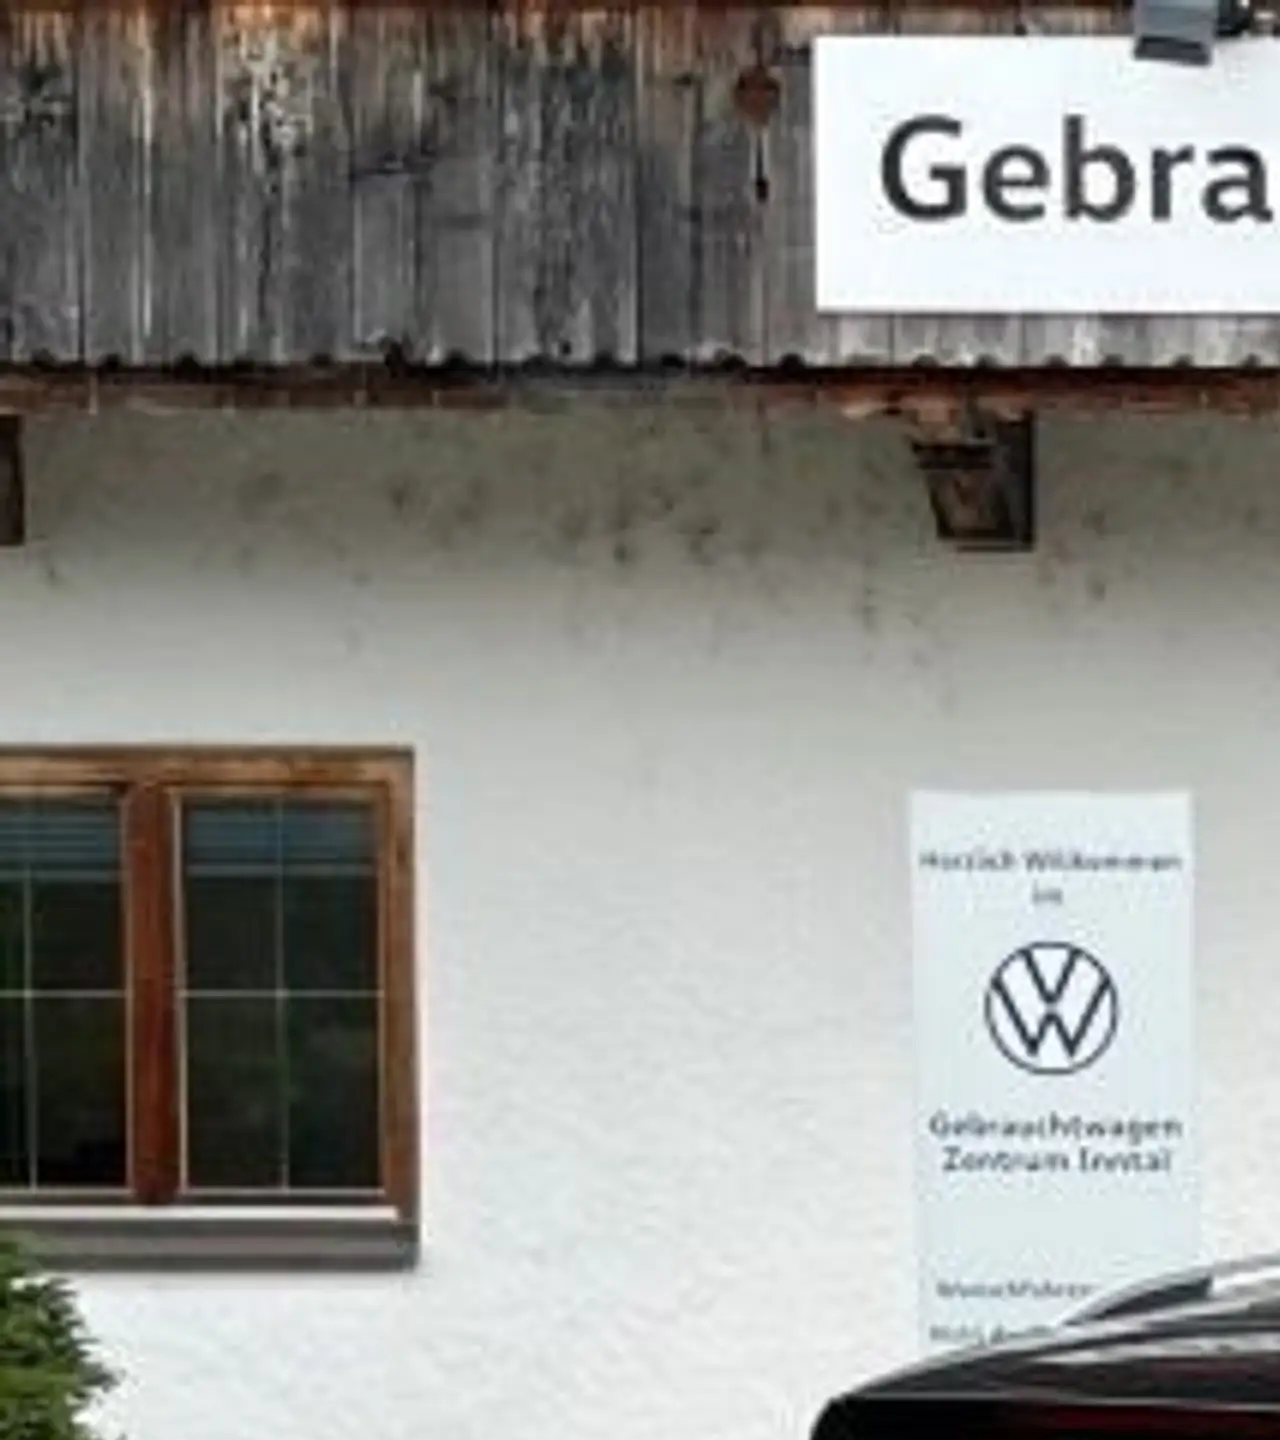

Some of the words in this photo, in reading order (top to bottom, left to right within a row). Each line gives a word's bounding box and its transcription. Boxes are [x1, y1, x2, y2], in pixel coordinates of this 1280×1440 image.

[1021, 847, 1183, 873] Willkommen
[927, 1108, 1184, 1141] Gebrauchtwagen
[941, 1144, 1071, 1174] Zentrum
[1077, 1143, 1173, 1174] Inntal
